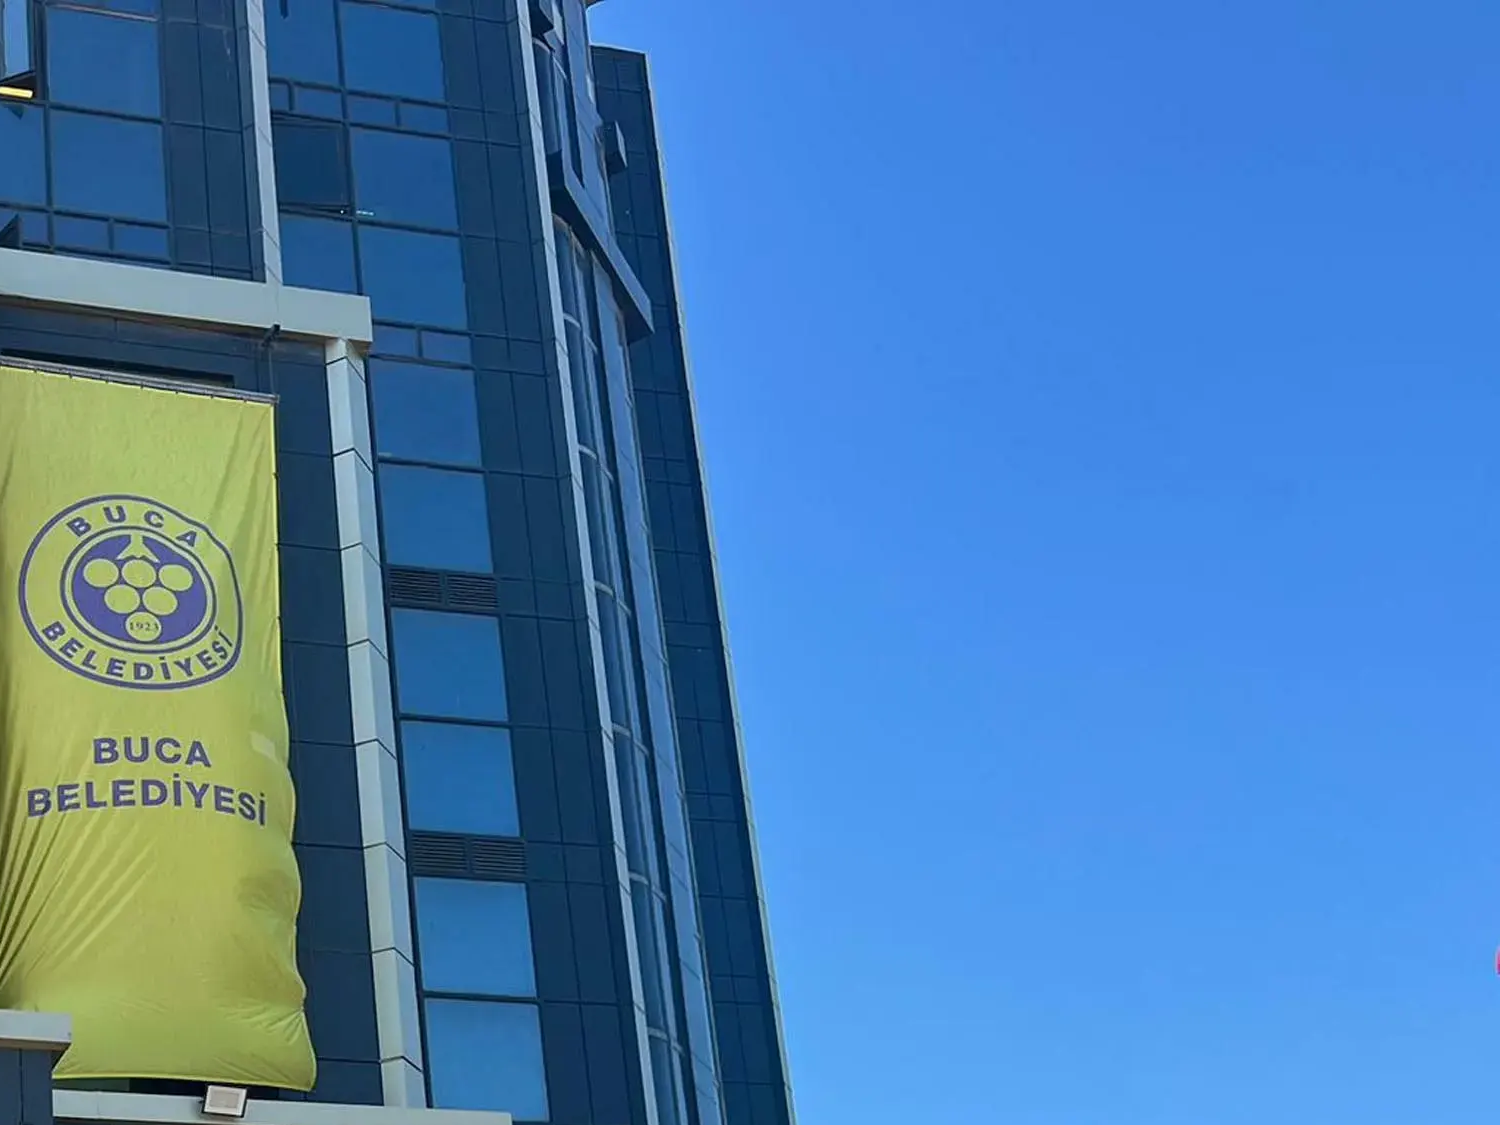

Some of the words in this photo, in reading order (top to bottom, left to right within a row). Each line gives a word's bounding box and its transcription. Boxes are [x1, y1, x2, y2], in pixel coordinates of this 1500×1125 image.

[66, 505, 198, 548] BUCA
[92, 736, 212, 768] BUCA
[26, 773, 266, 826] BELEDİYESİ
